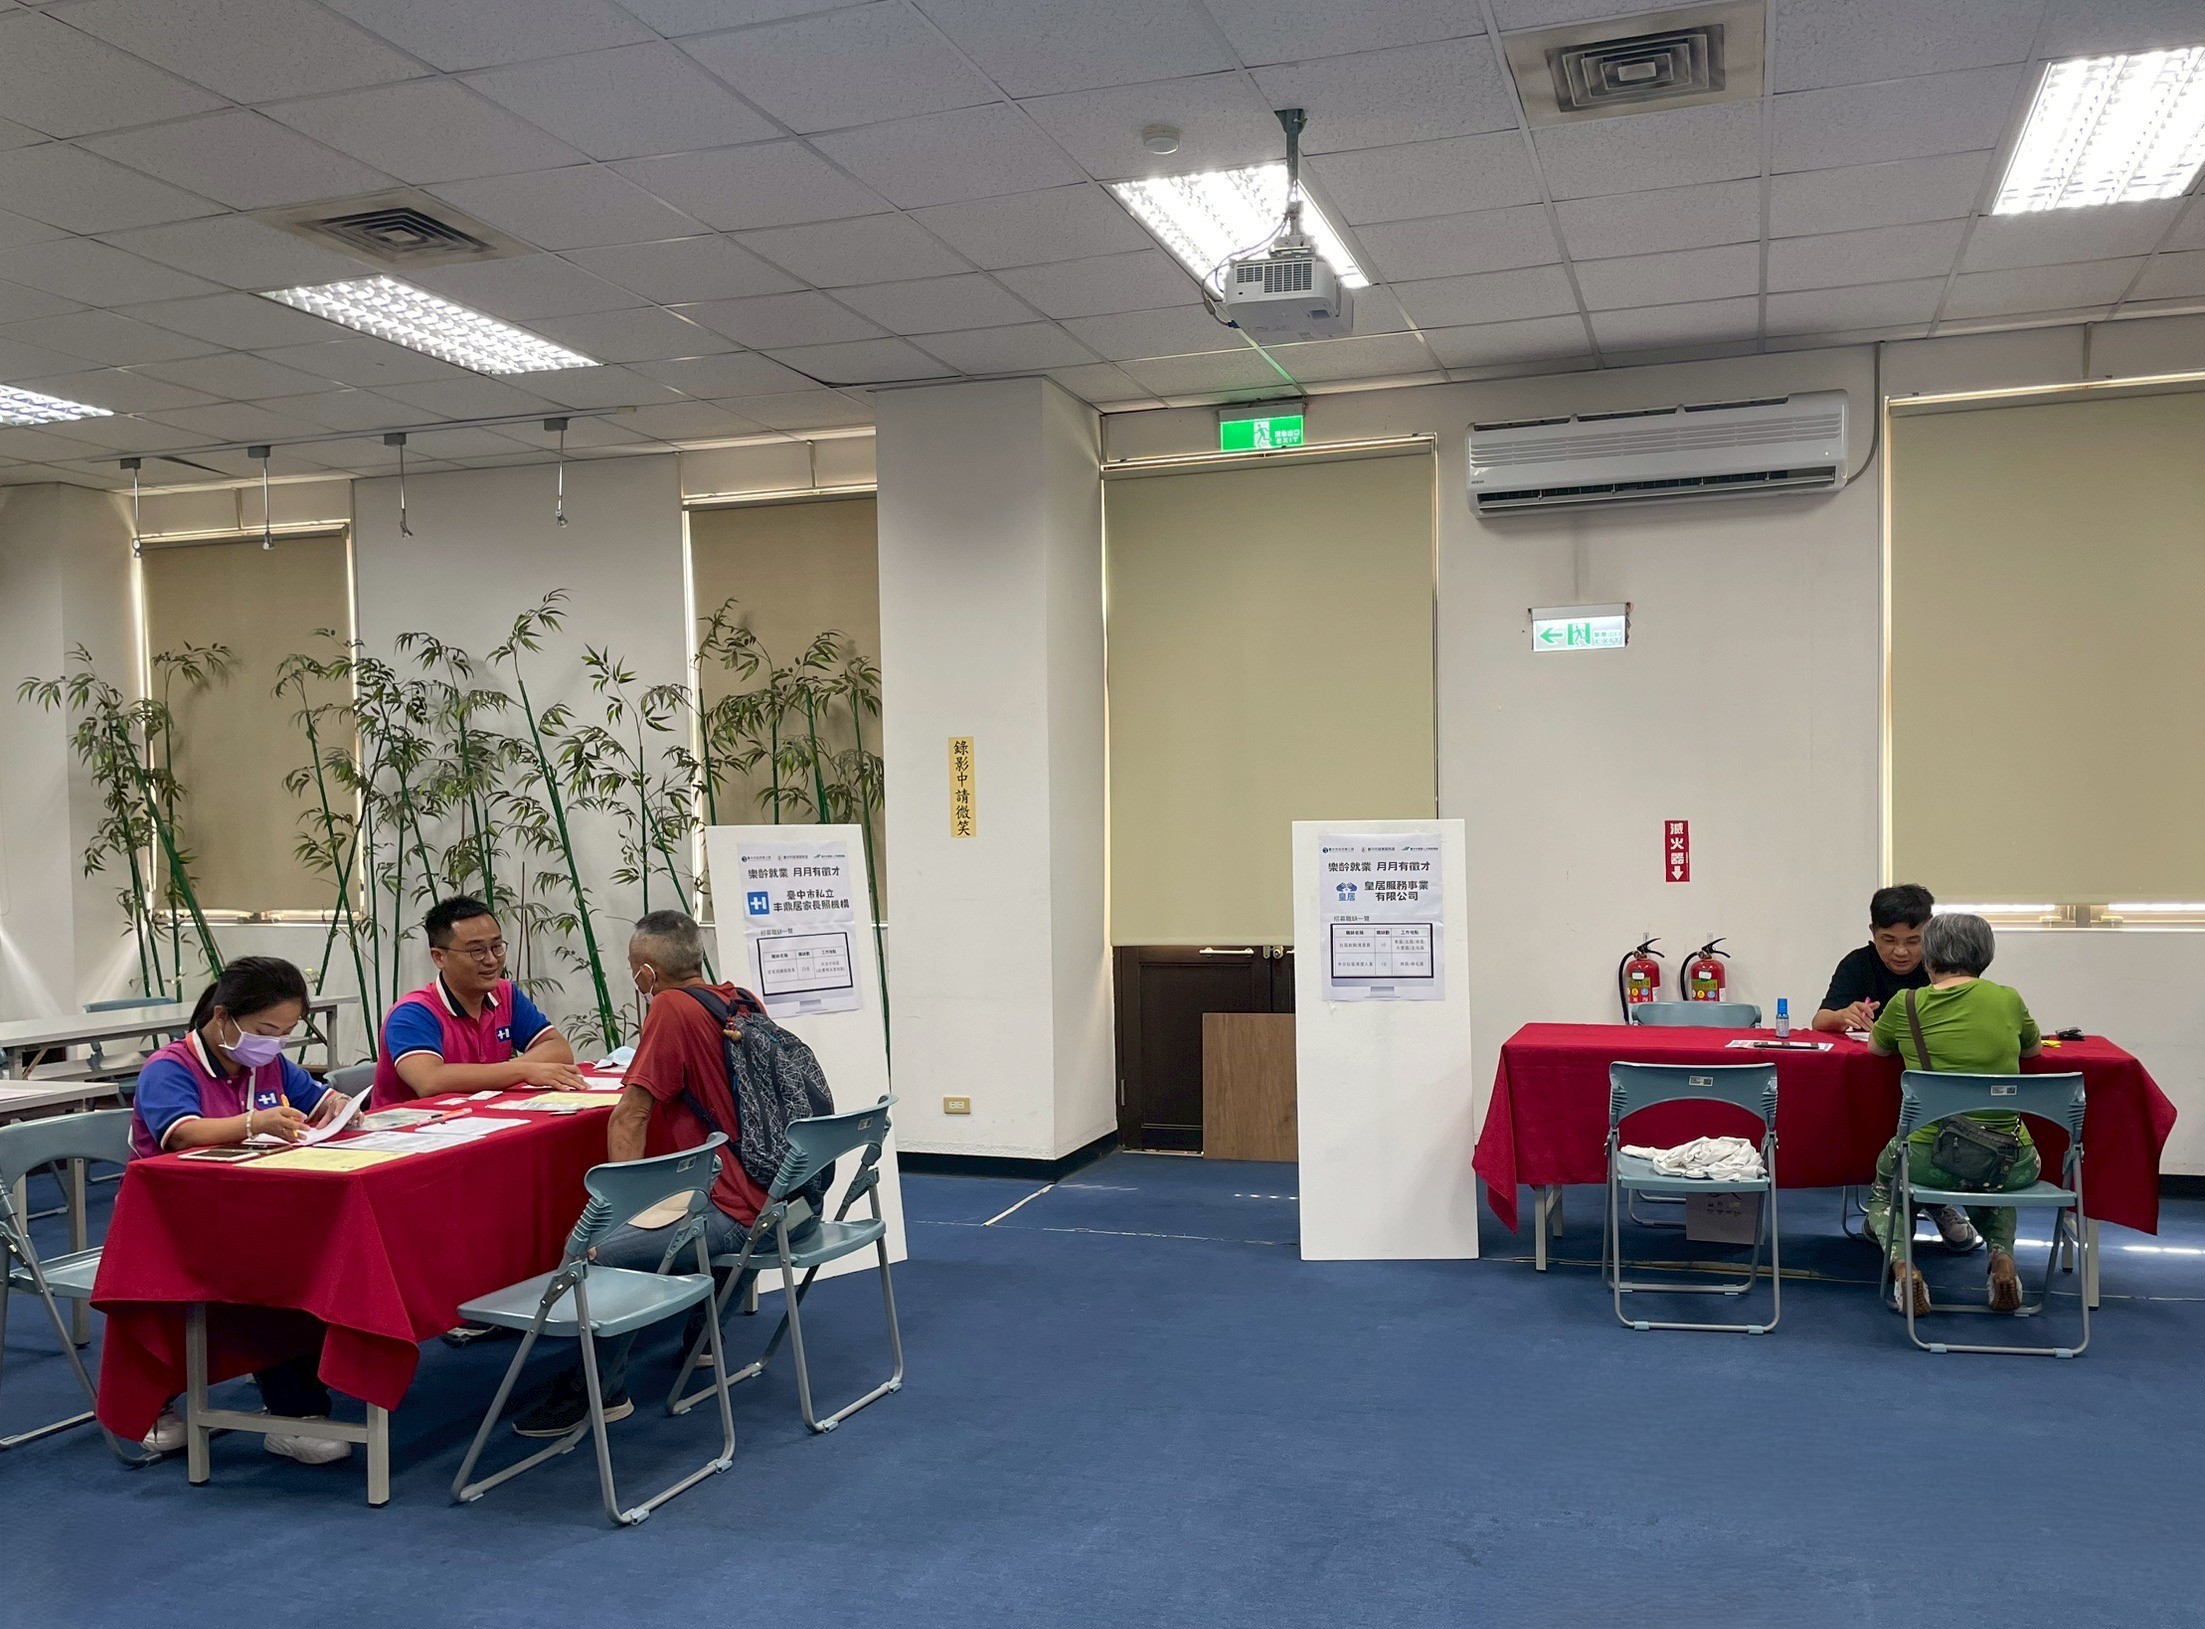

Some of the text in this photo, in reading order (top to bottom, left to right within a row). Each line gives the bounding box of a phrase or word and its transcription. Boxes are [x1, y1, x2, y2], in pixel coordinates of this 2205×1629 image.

[953, 740, 971, 836] 錄影中請微笑
[1670, 822, 1684, 865] 滅火器
[1328, 861, 1431, 872] 樂齡就業 月月有徵才
[748, 866, 840, 879] 樂齡就業 月月有徵才
[1364, 880, 1429, 891] 皇居服務事業
[786, 889, 834, 900] 臺中市私立
[1375, 891, 1419, 901] 有限公司
